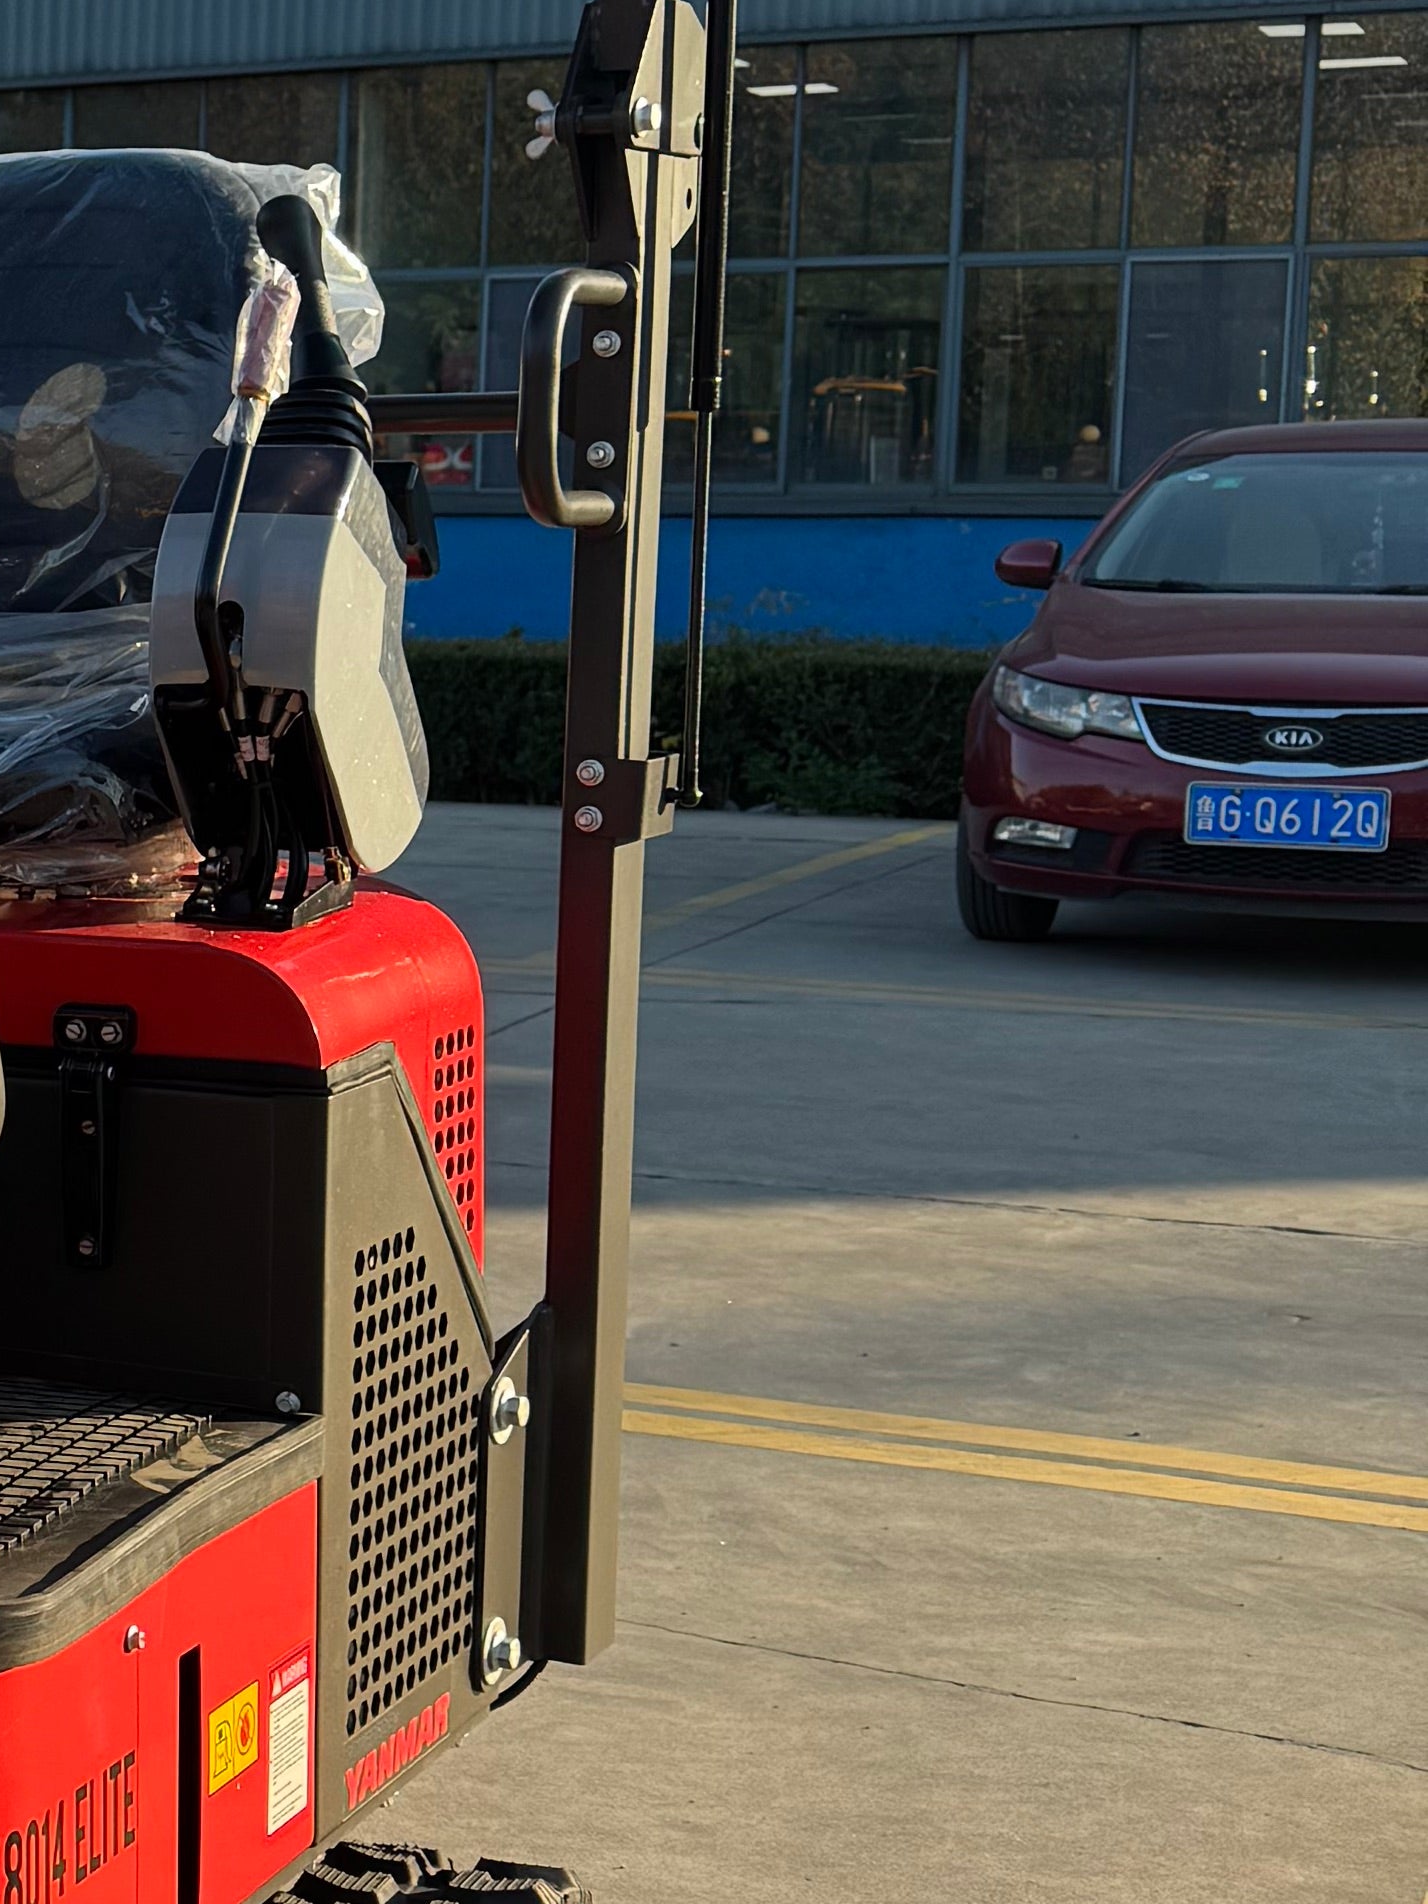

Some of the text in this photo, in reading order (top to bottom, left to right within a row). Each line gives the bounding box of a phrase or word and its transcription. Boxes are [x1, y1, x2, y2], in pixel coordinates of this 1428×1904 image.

[1274, 731, 1313, 745] KIA
[344, 1692, 451, 1812] YANMAR
[75, 1749, 136, 1884] ELITE
